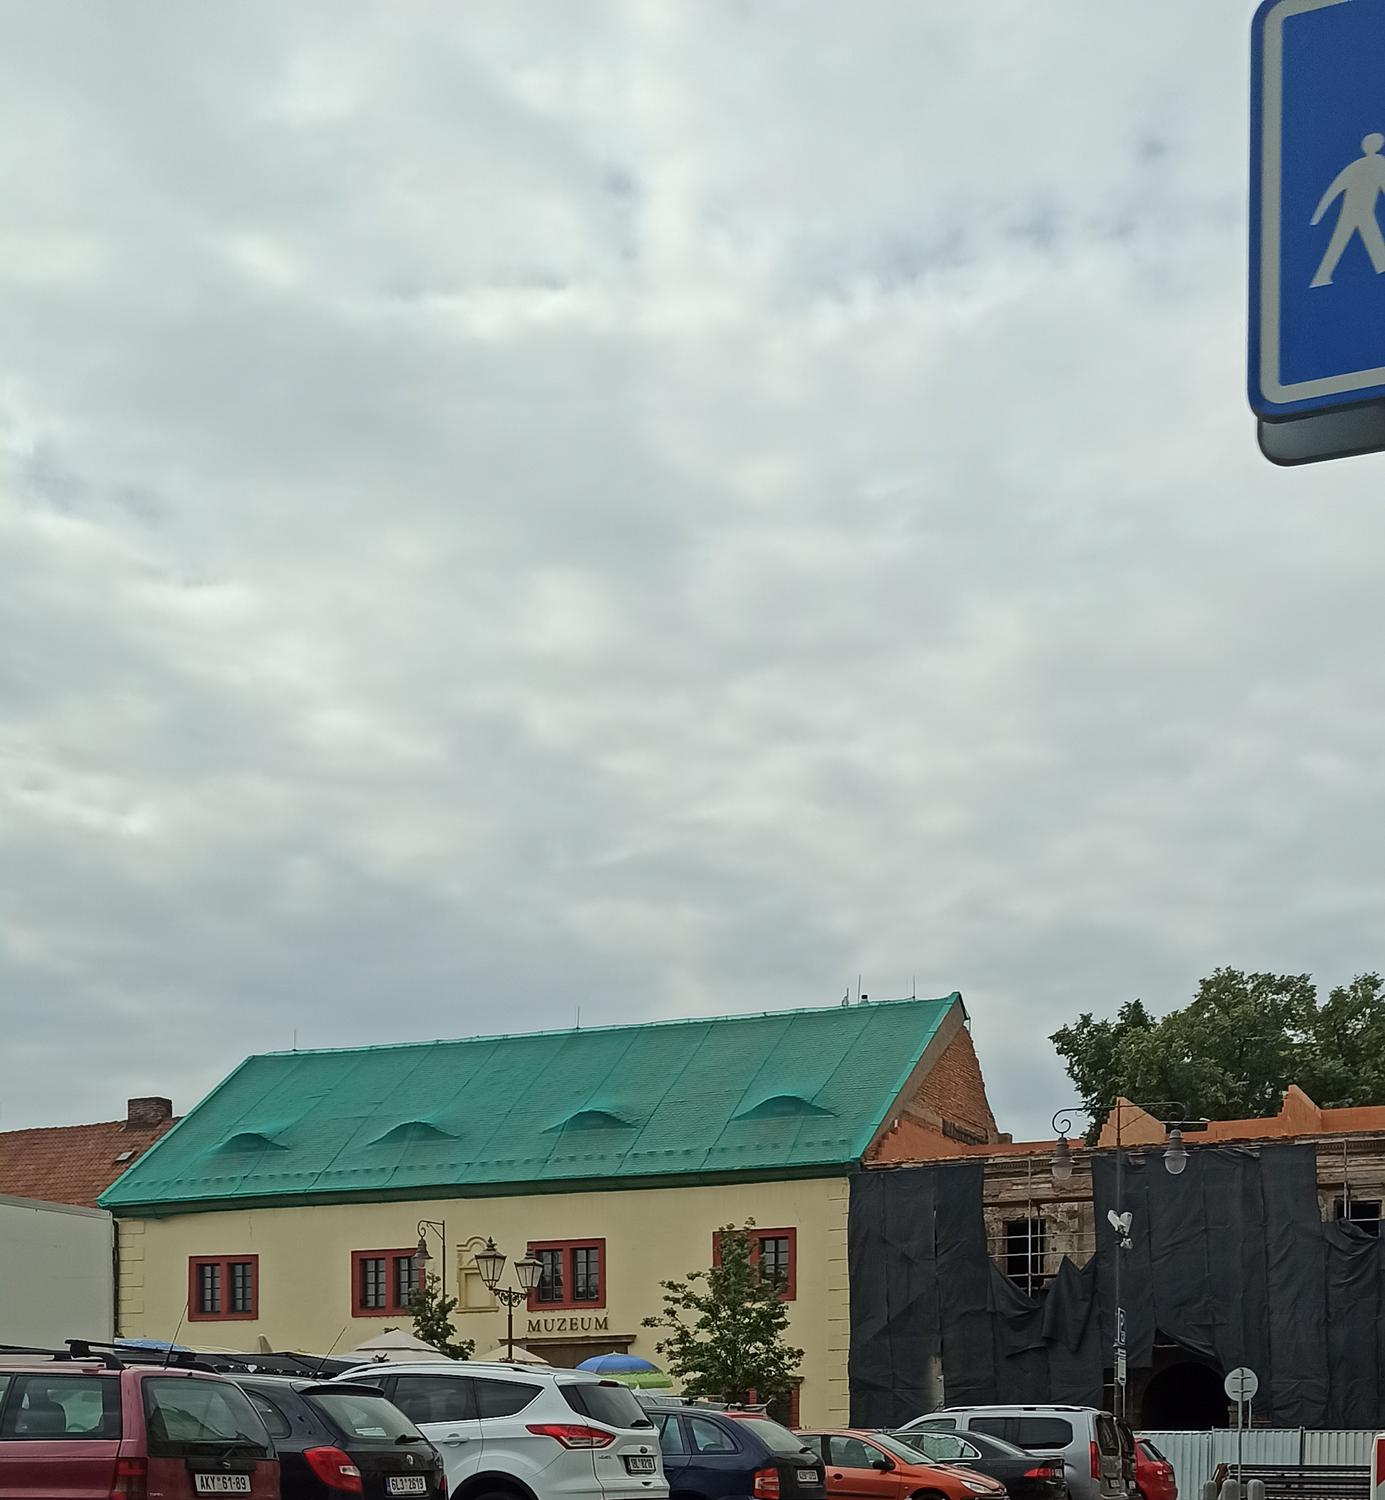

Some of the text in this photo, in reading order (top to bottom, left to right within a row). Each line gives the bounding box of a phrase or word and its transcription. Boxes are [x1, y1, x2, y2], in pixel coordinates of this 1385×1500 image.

[527, 1316, 608, 1333] MUZEUM
[200, 1475, 247, 1490] AKY 61-89
